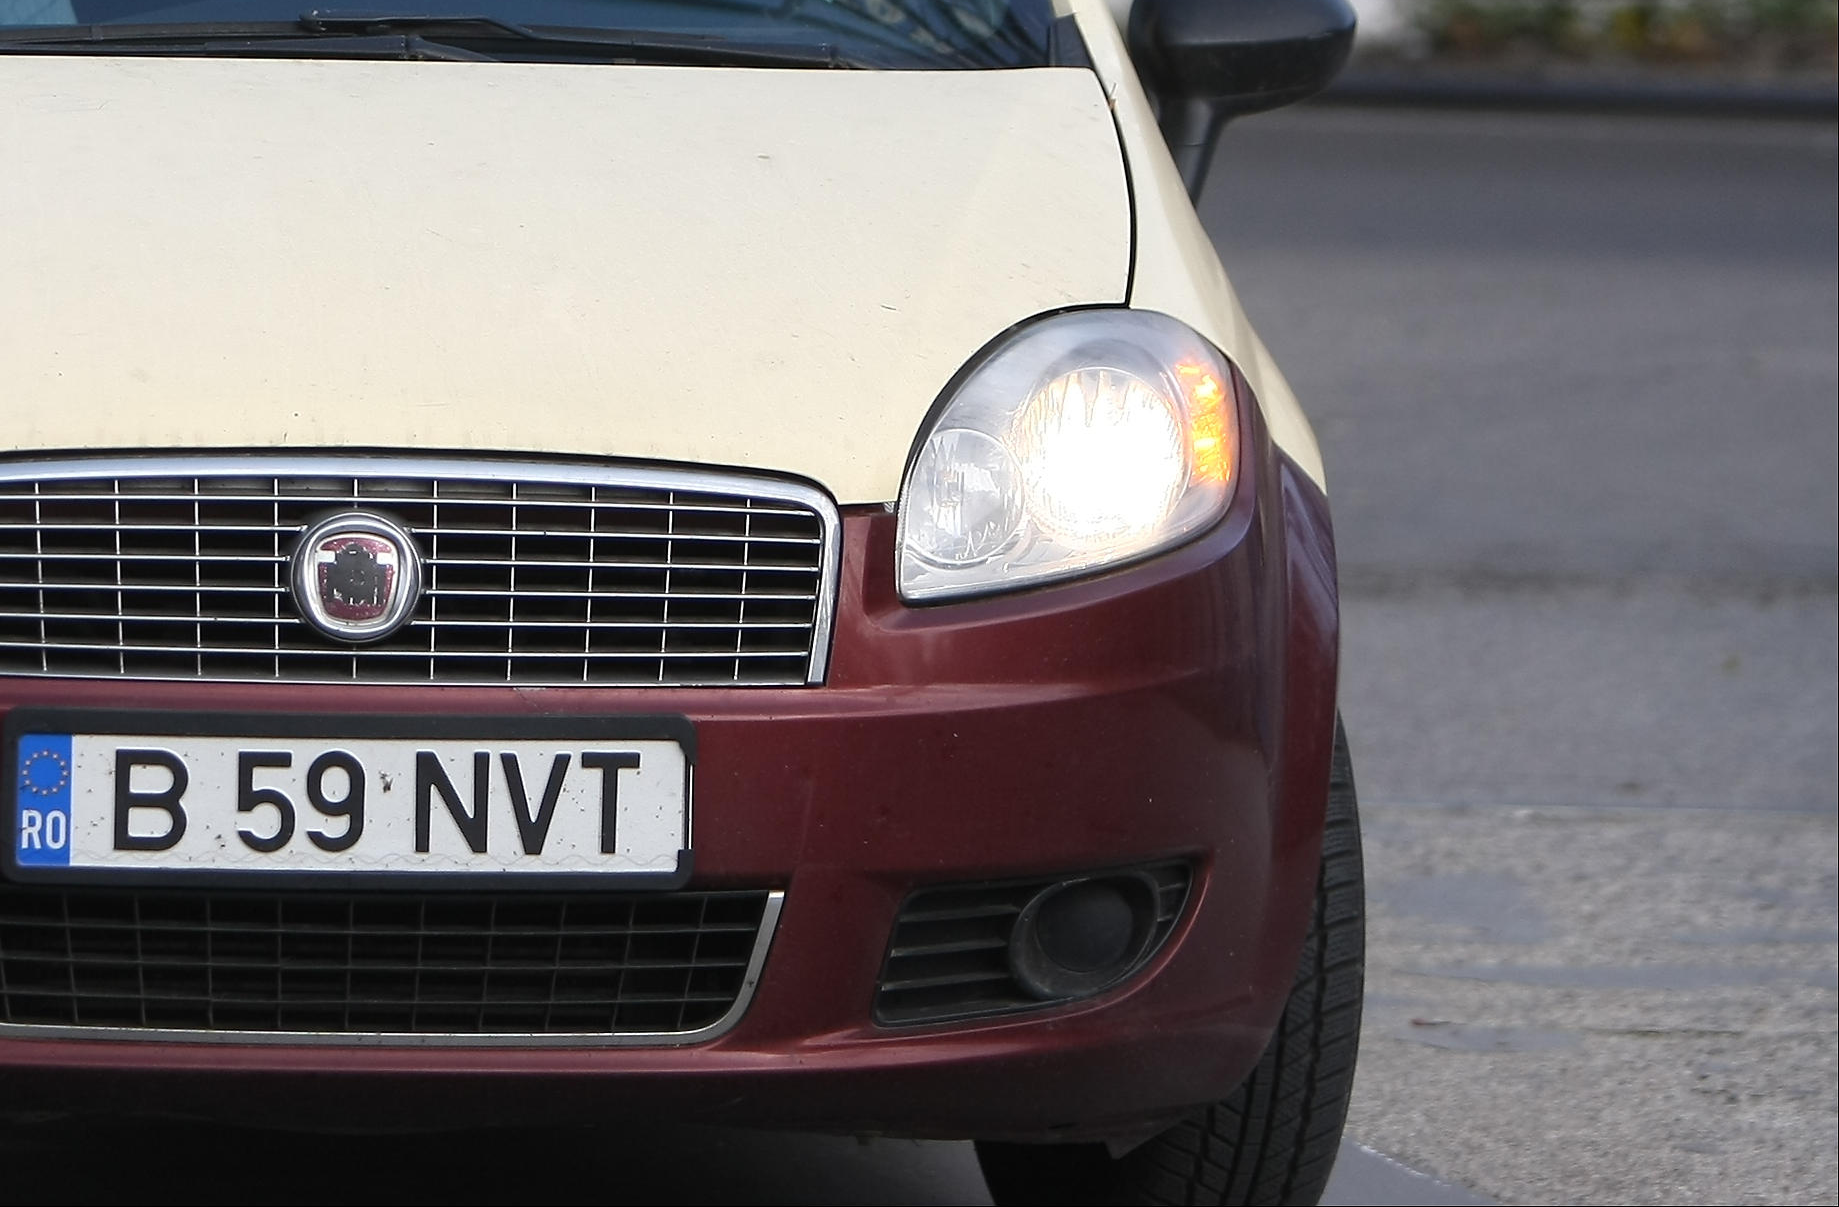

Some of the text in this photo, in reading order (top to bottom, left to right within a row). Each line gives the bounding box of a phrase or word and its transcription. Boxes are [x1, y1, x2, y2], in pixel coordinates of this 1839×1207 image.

[21, 809, 66, 850] RO
[112, 748, 641, 856] B 59 NVT
